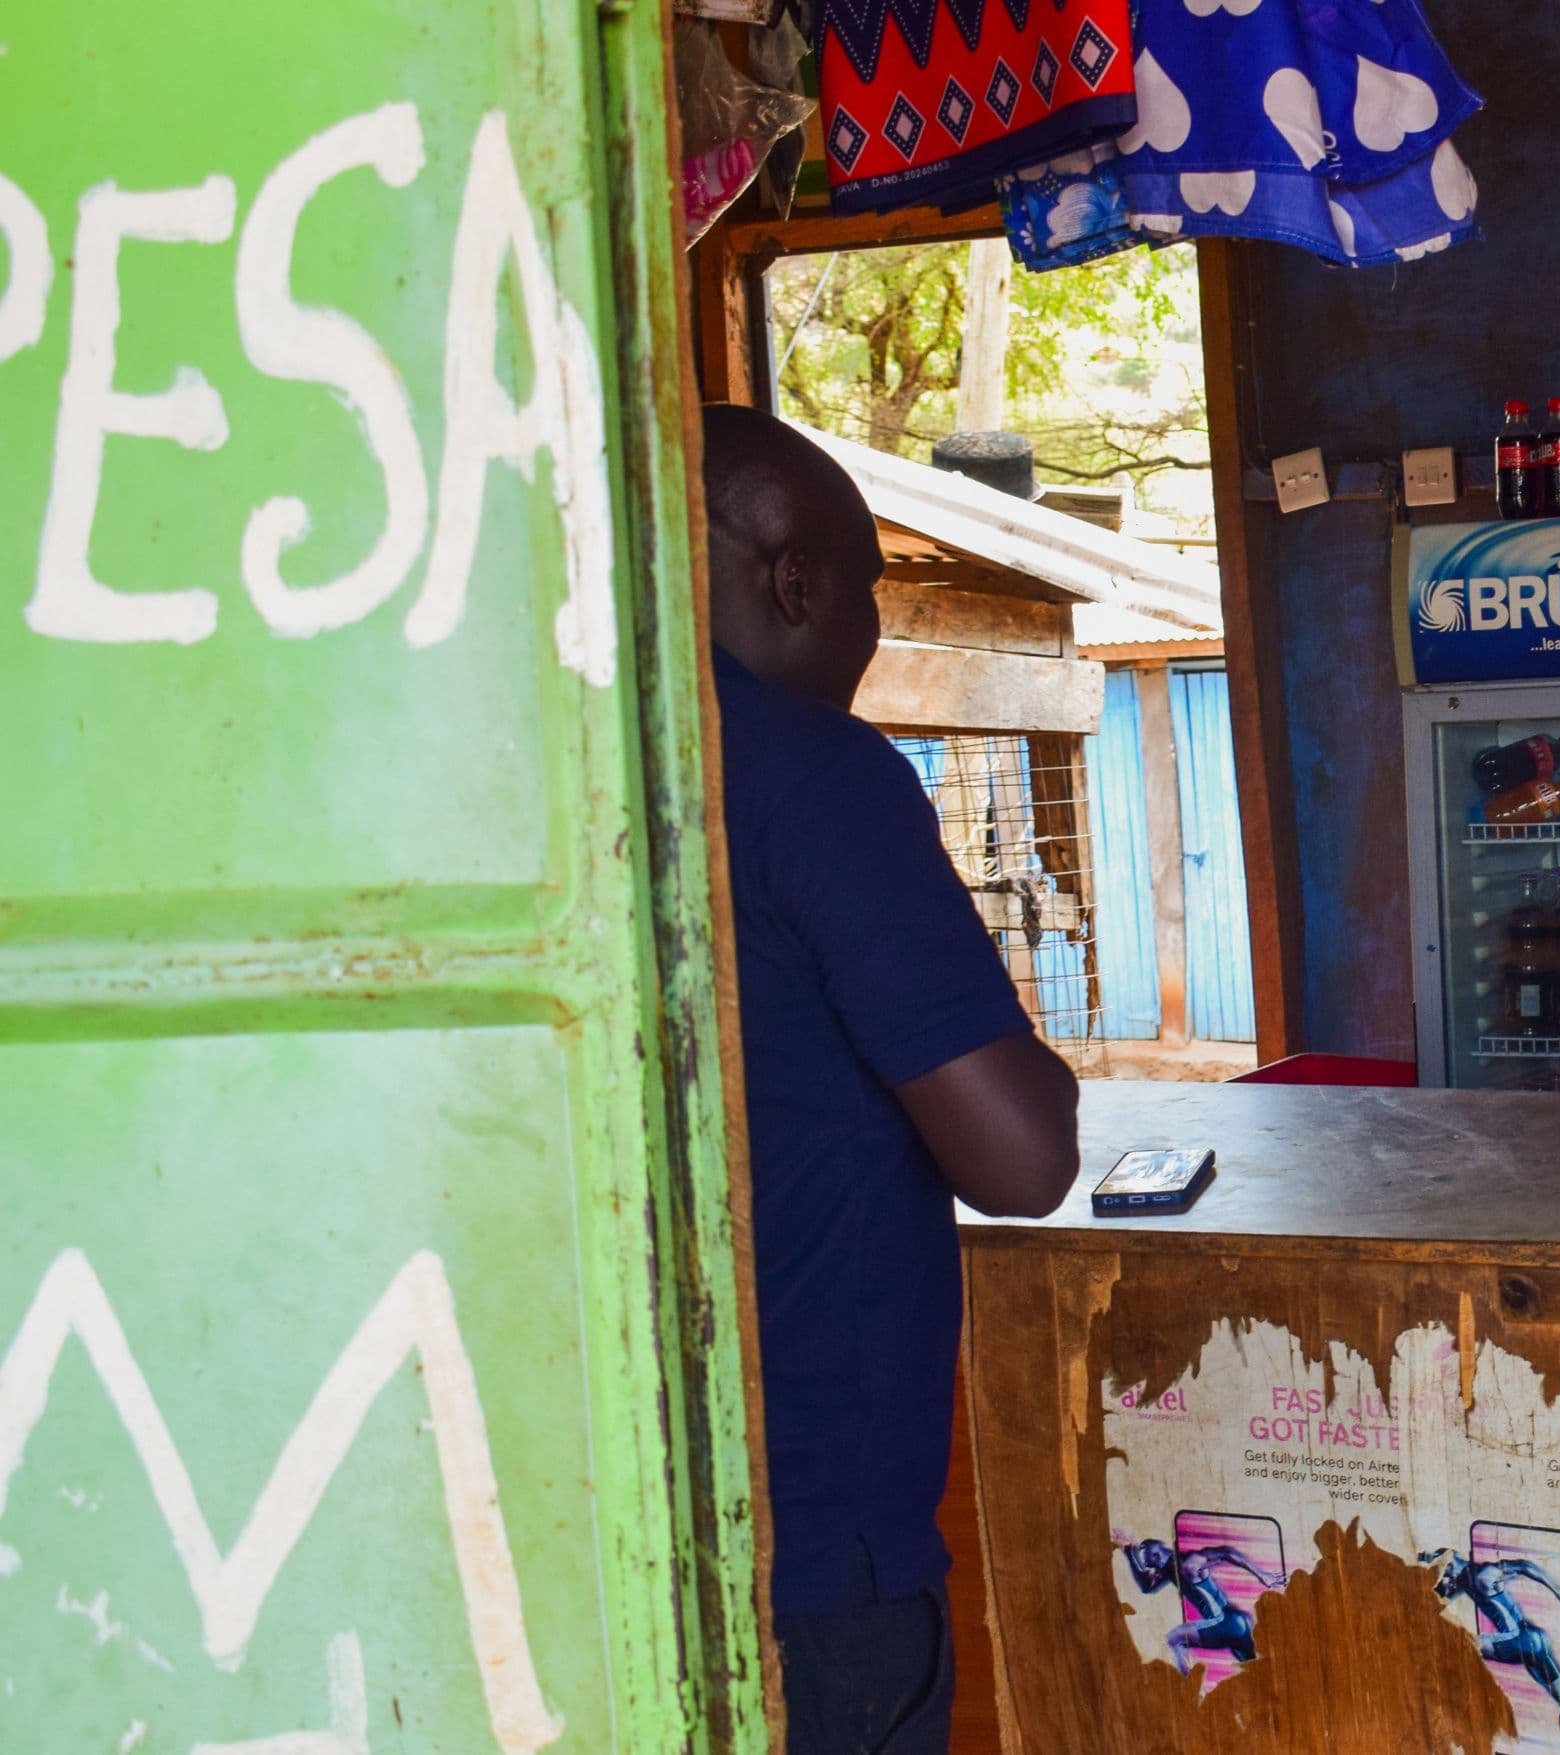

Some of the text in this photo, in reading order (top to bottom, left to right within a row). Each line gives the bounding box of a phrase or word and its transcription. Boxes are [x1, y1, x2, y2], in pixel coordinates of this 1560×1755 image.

[1249, 1416, 1309, 1443] GOT
[1244, 1450, 1268, 1462] Get
[1271, 1452, 1298, 1467] fully
[1301, 1455, 1344, 1469] locked
[1347, 1461, 1364, 1471] on
[1244, 1465, 1268, 1478] and
[1272, 1469, 1307, 1483] enjoy
[1359, 1475, 1399, 1489] better
[1328, 1489, 1364, 1501] wider
